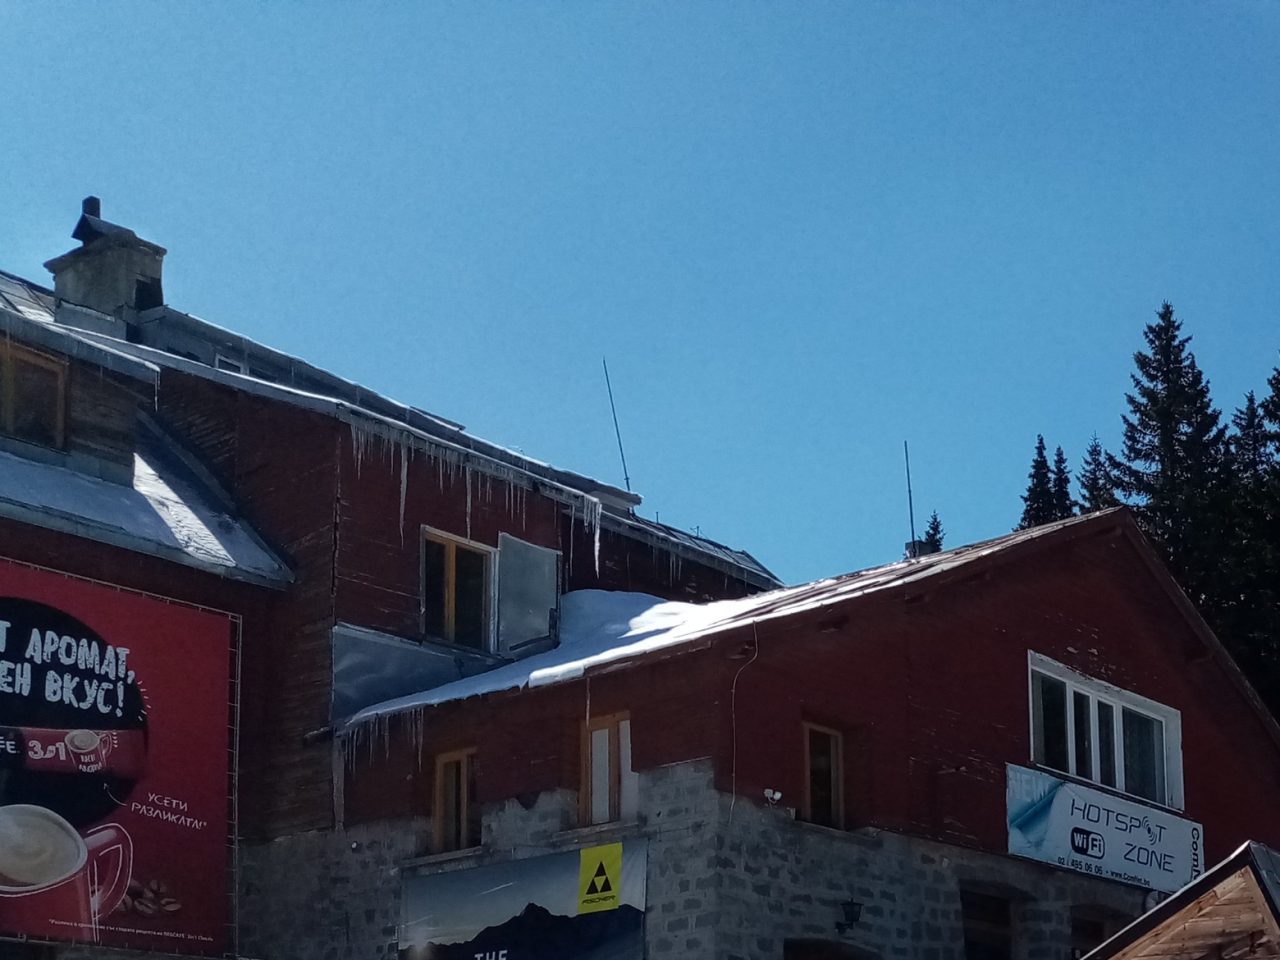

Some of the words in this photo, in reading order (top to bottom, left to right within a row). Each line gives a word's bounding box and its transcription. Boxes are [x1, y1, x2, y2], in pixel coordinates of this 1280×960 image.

[25, 628, 136, 685] АРОМАТ,
[45, 669, 124, 717] ВКУС!
[148, 792, 188, 812] УСЕТИ
[1123, 842, 1176, 873] ZONE
